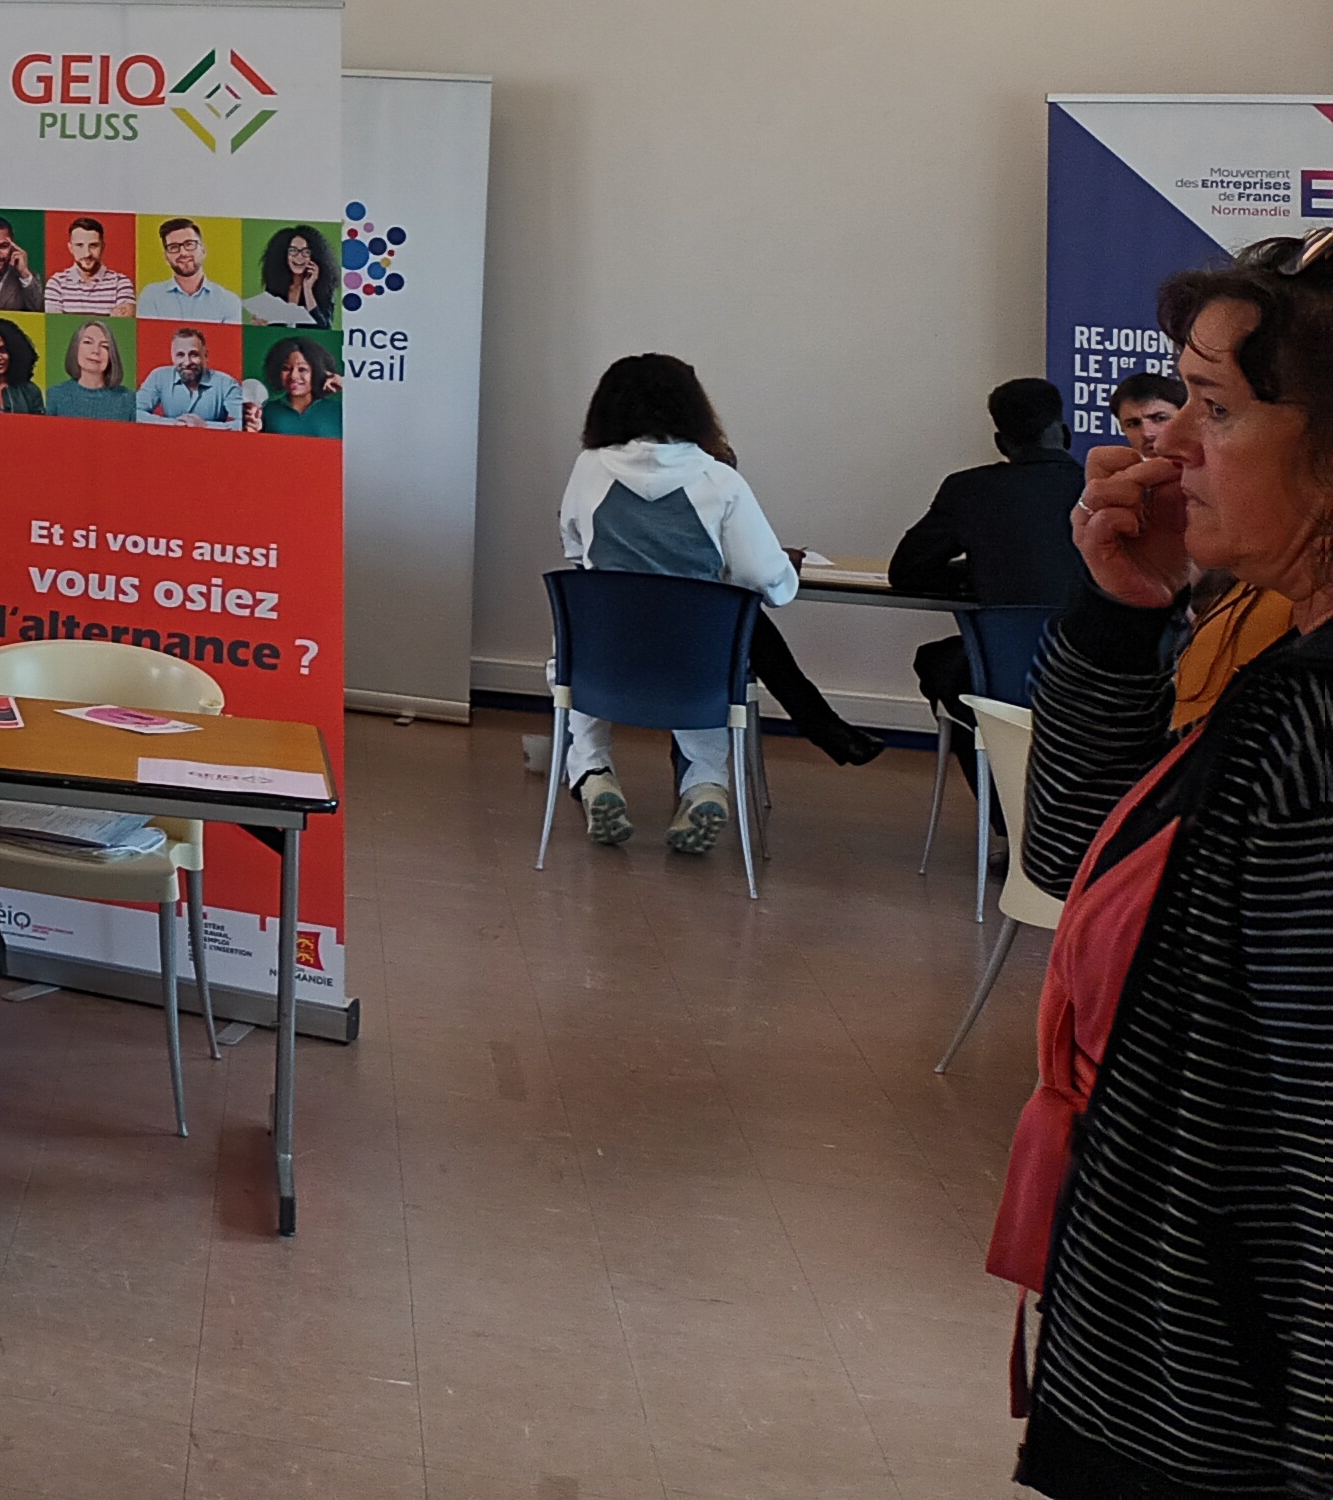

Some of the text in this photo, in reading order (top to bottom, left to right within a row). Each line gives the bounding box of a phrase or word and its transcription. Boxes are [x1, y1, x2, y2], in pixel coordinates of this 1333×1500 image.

[11, 53, 166, 106] GEIQ
[39, 111, 139, 141] PLUSS
[1175, 178, 1291, 191] des Entreprises
[1210, 167, 1290, 179] Mouvement
[1218, 191, 1291, 203] de France
[1211, 205, 1291, 217] Normandie
[348, 327, 408, 351] nce
[1074, 325, 1179, 354] REJOIGN
[348, 355, 405, 382] vail
[1075, 354, 1103, 377] LE
[1108, 356, 1137, 378] 1er
[1074, 381, 1117, 407] D'E
[1074, 410, 1103, 434] DE
[30, 520, 278, 568] Et si vous aussi
[28, 566, 279, 620] vous osiez
[294, 638, 319, 675] ?
